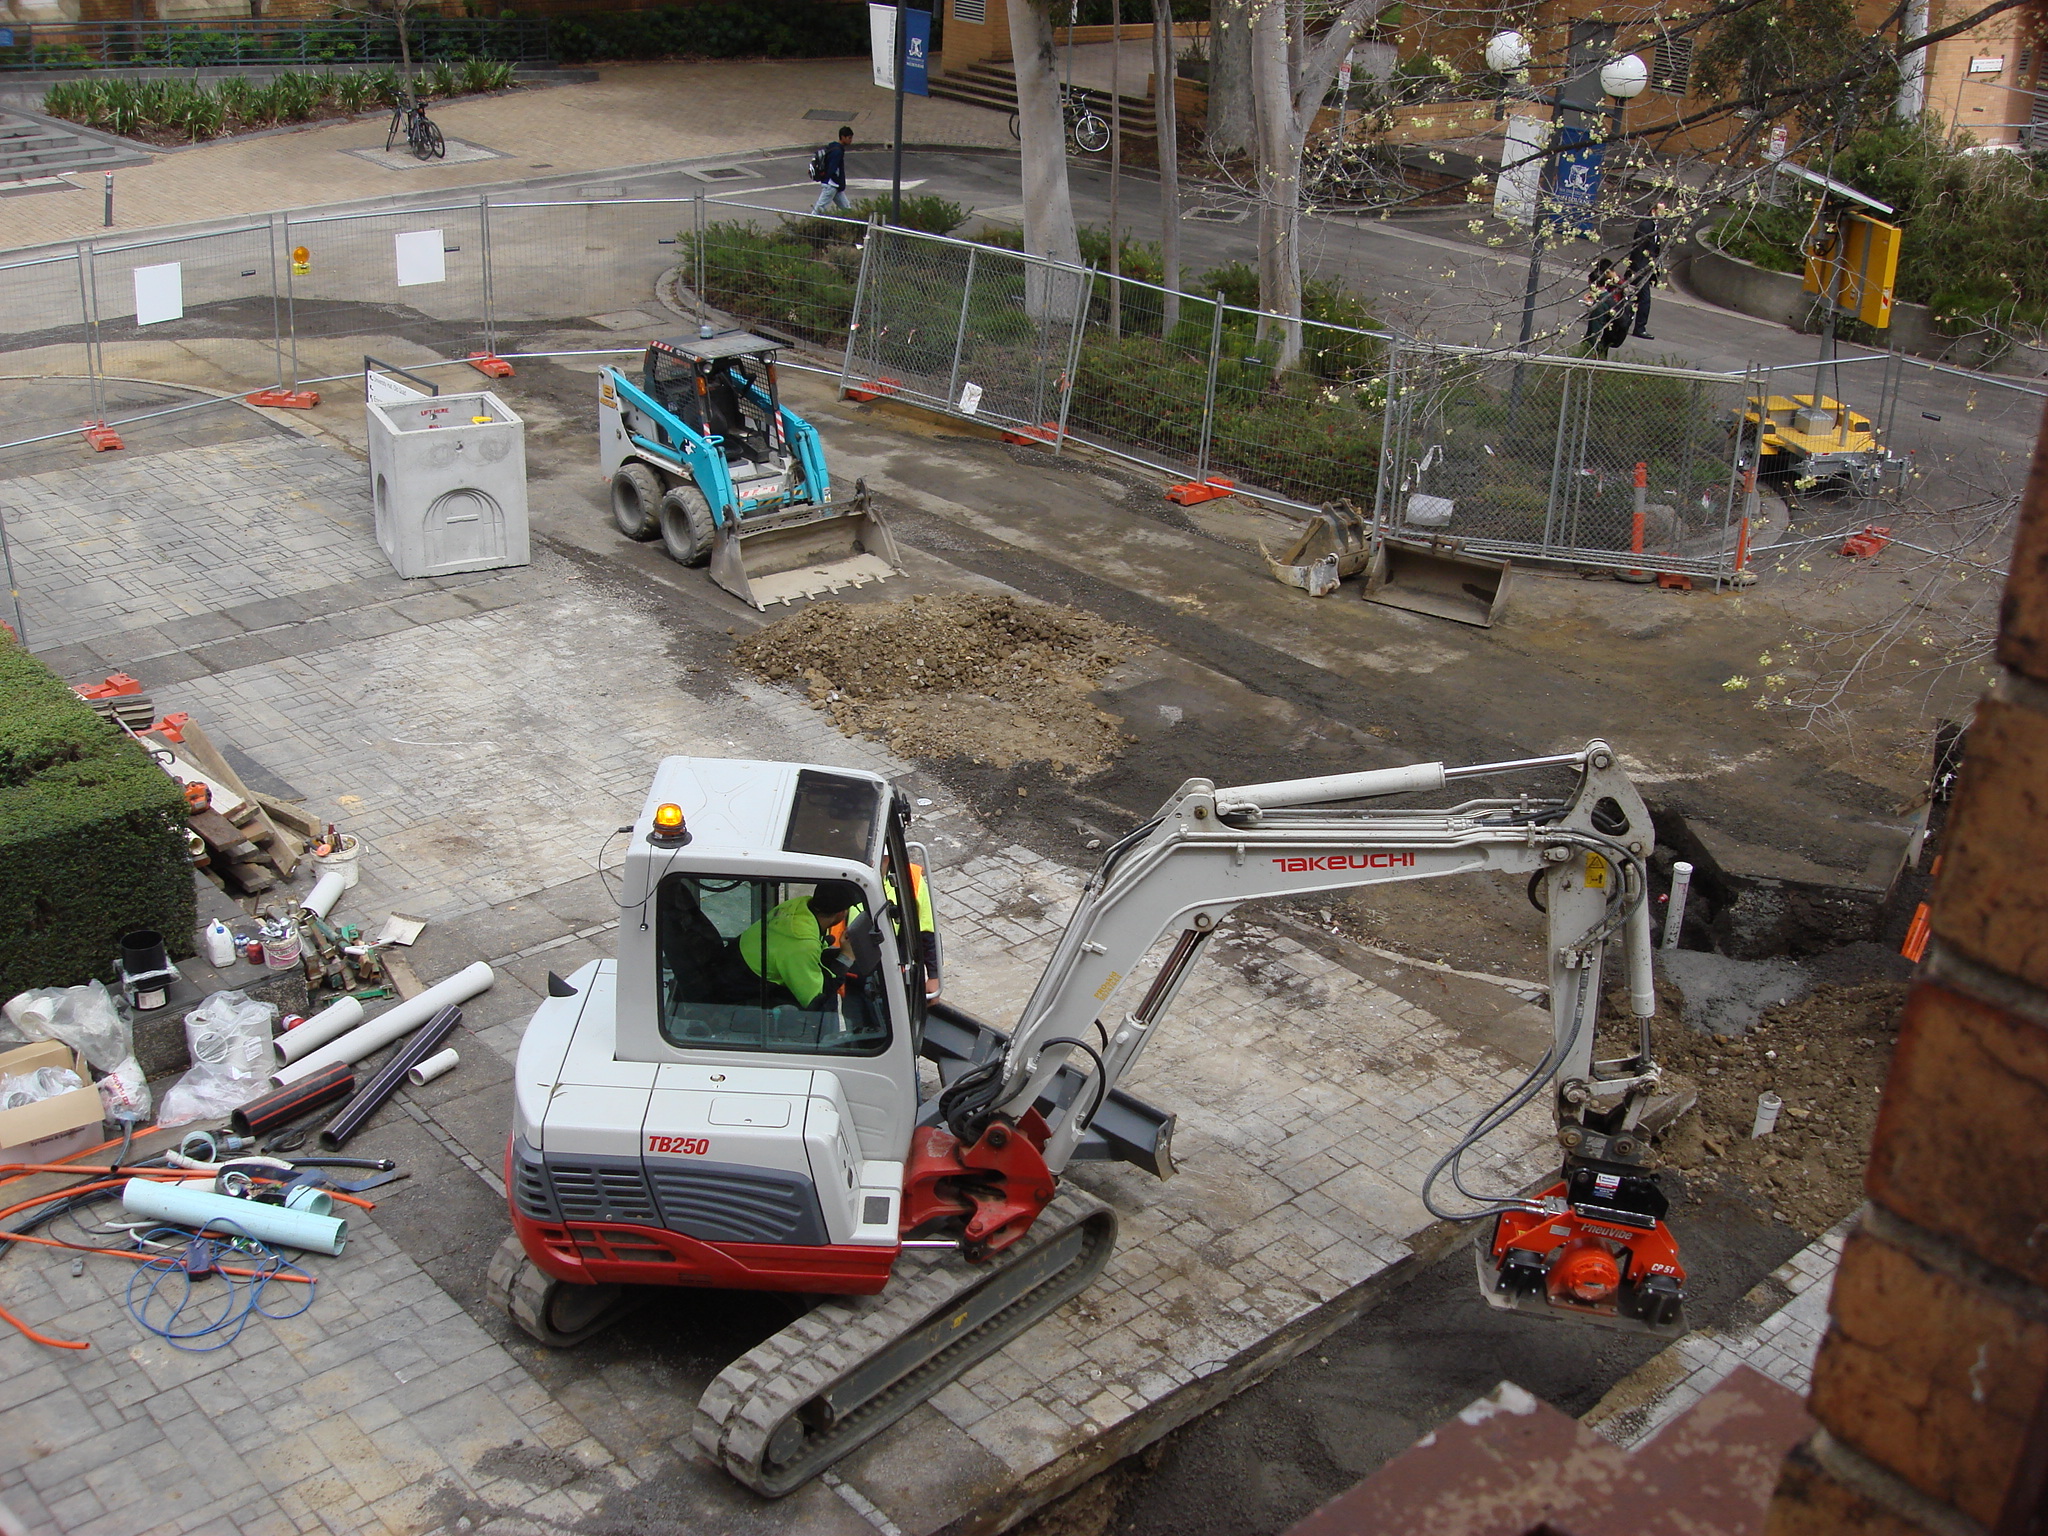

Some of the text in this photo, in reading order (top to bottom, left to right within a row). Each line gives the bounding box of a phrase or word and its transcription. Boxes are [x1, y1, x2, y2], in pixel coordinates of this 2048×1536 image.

[1272, 852, 1415, 872] TAKEUCHI
[649, 1136, 710, 1155] TB250
[1581, 1222, 1633, 1240] PneuVibe
[1651, 1263, 1676, 1274] CP 51
